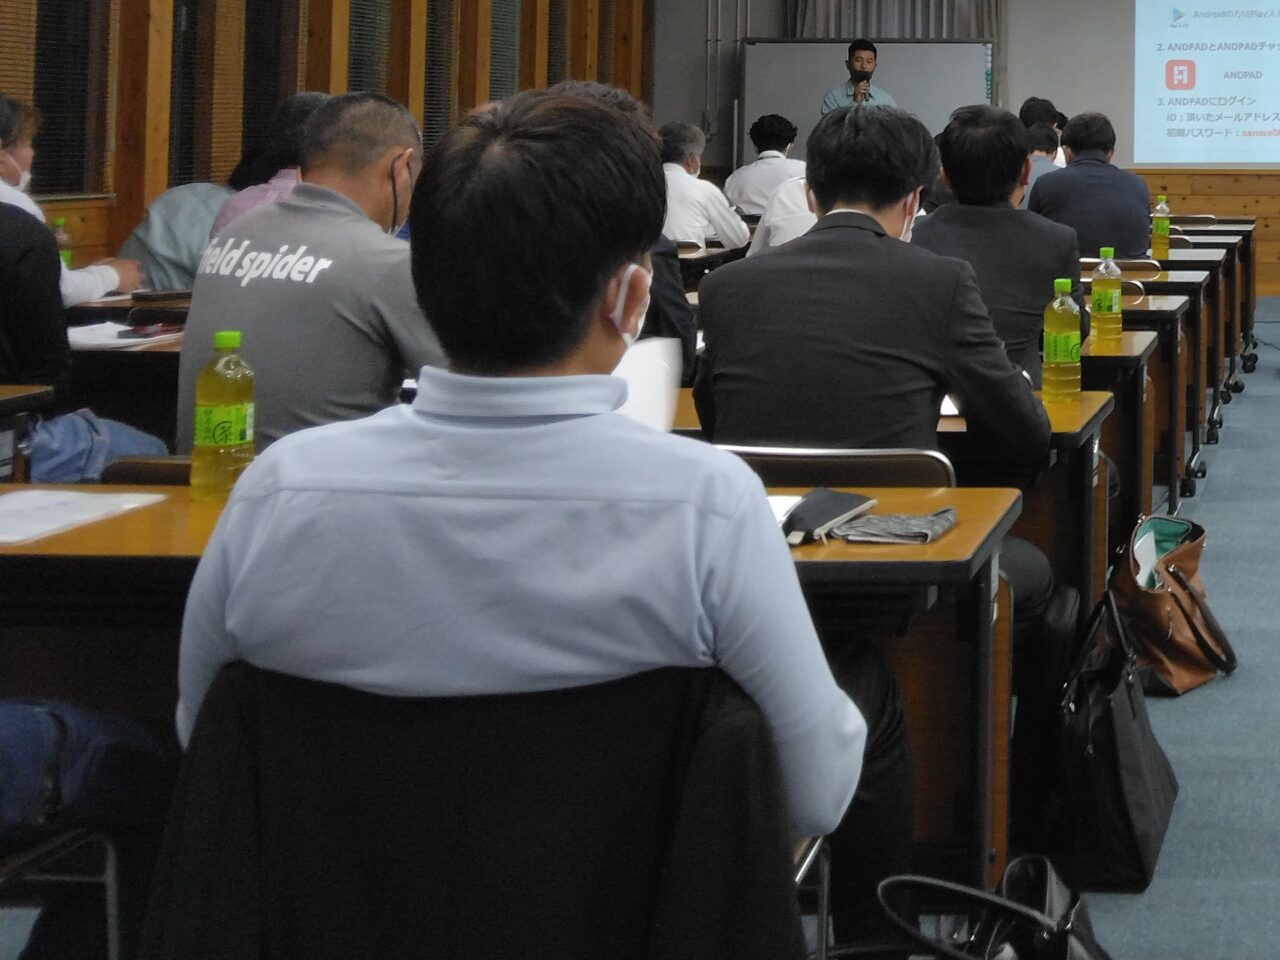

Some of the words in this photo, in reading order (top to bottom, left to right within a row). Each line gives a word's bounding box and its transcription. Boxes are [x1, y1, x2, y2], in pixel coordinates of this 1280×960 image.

[1223, 71, 1263, 80] ANDPAD
[1167, 96, 1257, 106] ANDPADにログイン
[234, 244, 334, 288] spider
